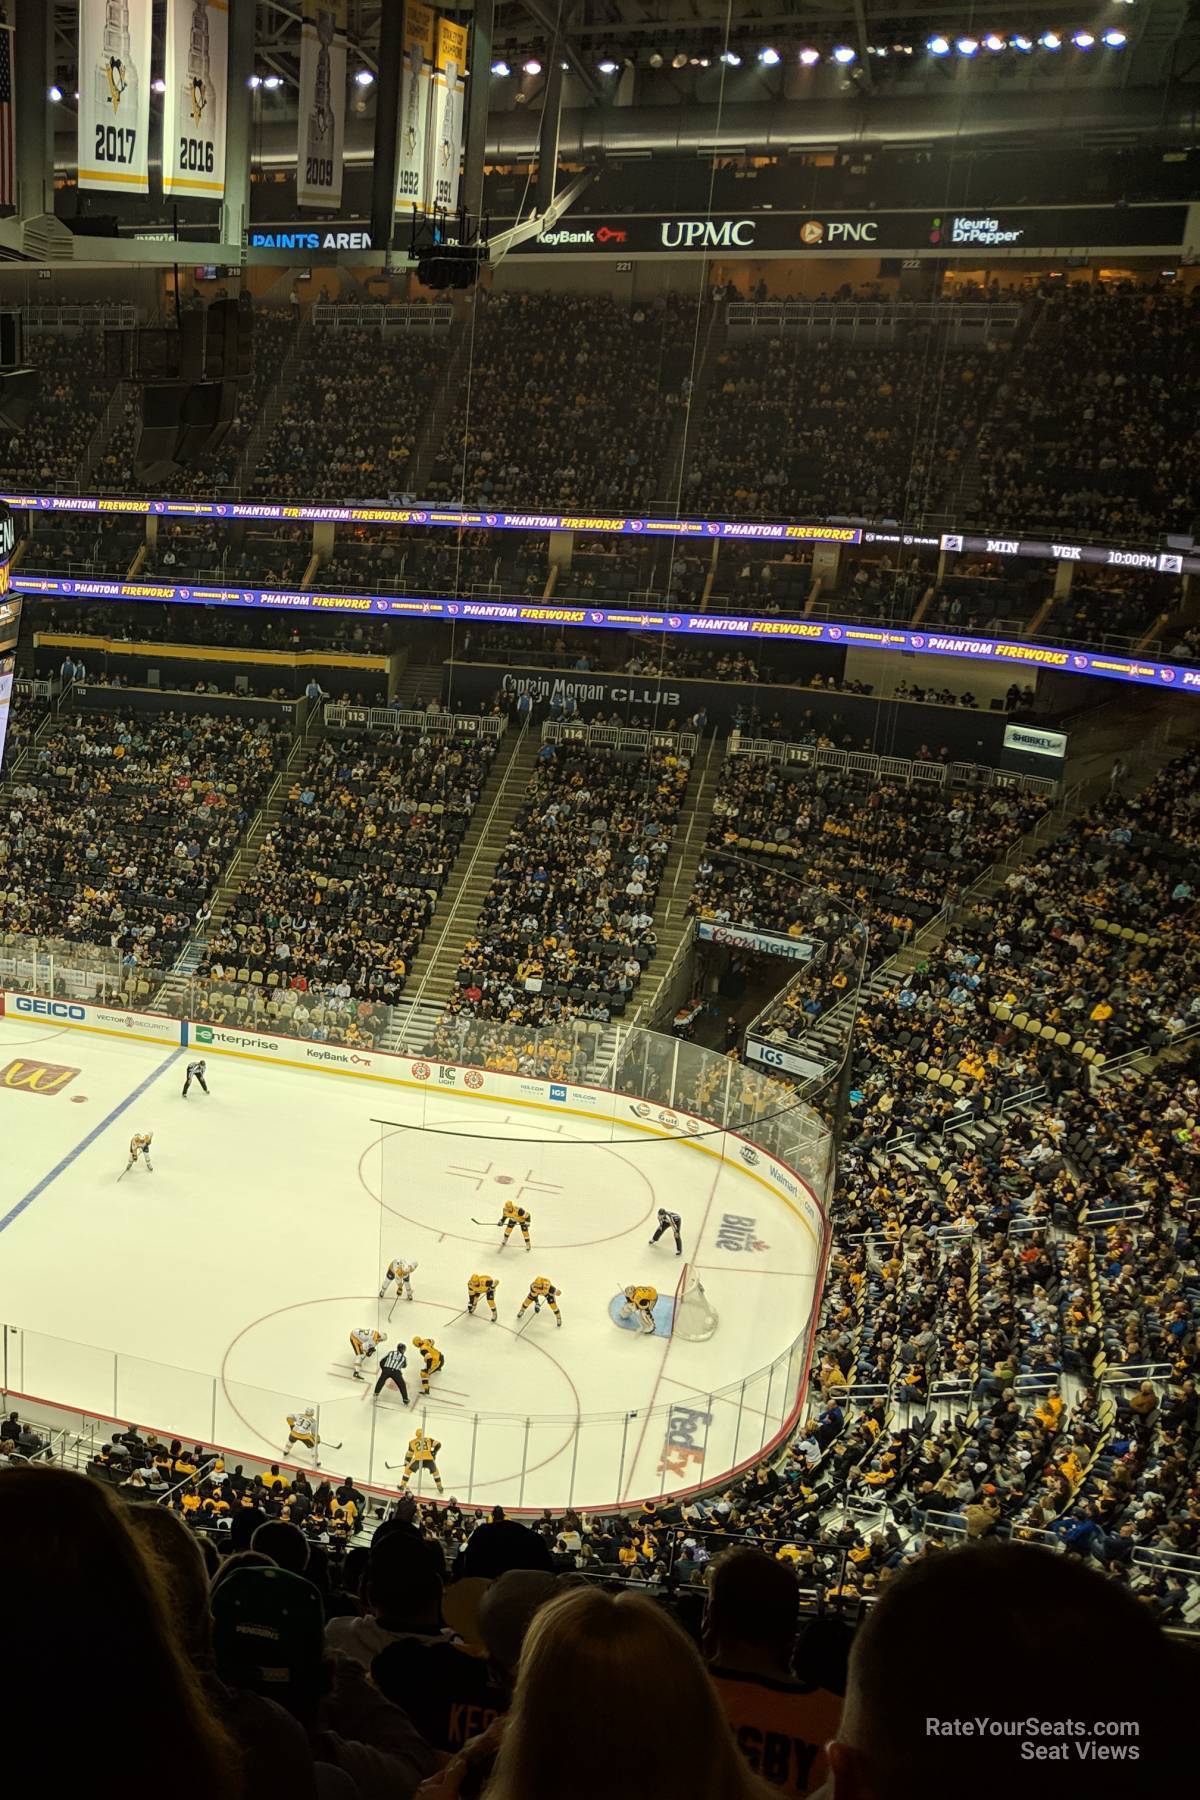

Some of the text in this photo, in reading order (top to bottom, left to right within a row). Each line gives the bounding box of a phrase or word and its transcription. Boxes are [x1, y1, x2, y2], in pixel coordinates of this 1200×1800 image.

[95, 124, 137, 165] 2017
[180, 137, 214, 173] 2016
[306, 157, 333, 187] 2009
[399, 170, 419, 196] 1992
[436, 180, 452, 204] 1991
[827, 222, 879, 241] PNC
[953, 217, 999, 232] Keurig
[253, 232, 372, 250] PAINTS AREN
[536, 231, 595, 245] KeyBank
[660, 221, 757, 247] UPMC
[902, 260, 921, 269] 222
[52, 499, 151, 513] PHANTOM FIREWORKS
[232, 506, 280, 518] PHANTOM
[300, 508, 411, 523] PHANTOM FIREWORKS
[503, 515, 626, 531] PHANTOM FIREWORKS
[723, 524, 856, 541] PHANTOM FIREWORKS
[986, 540, 1157, 568] MIN VGK 10:00PM
[74, 583, 176, 598] PHANTOM FIREWORKS
[260, 594, 372, 609] PHANTOM FIREWORKS
[463, 604, 586, 622] PHANTOM FIREWORKS
[689, 617, 823, 637] PHANTOM FIREWORKS
[928, 637, 1069, 666] PHANTOM FIREWORKS
[503, 674, 680, 706] Captain Morgan CLUB
[347, 711, 367, 723] 113
[457, 720, 477, 731] 113
[564, 728, 584, 740] 114
[656, 737, 674, 748] 114
[790, 749, 810, 761] 115
[711, 926, 757, 951] Coors
[15, 997, 86, 1021] GEICO
[96, 1014, 171, 1032] VECTOR SECURITY
[200, 1028, 279, 1051] enterprise
[306, 1048, 349, 1064] KeyBank
[759, 1046, 784, 1066] IGS
[438, 1078, 456, 1086] LIGHT
[439, 1066, 456, 1081] IC
[552, 1089, 566, 1098] IGS
[659, 1115, 677, 1126] Gulf
[769, 1165, 798, 1196] Walmart
[715, 1213, 757, 1252] Blue
[296, 1417, 311, 1430] 33
[657, 1406, 713, 1478] FedEx
